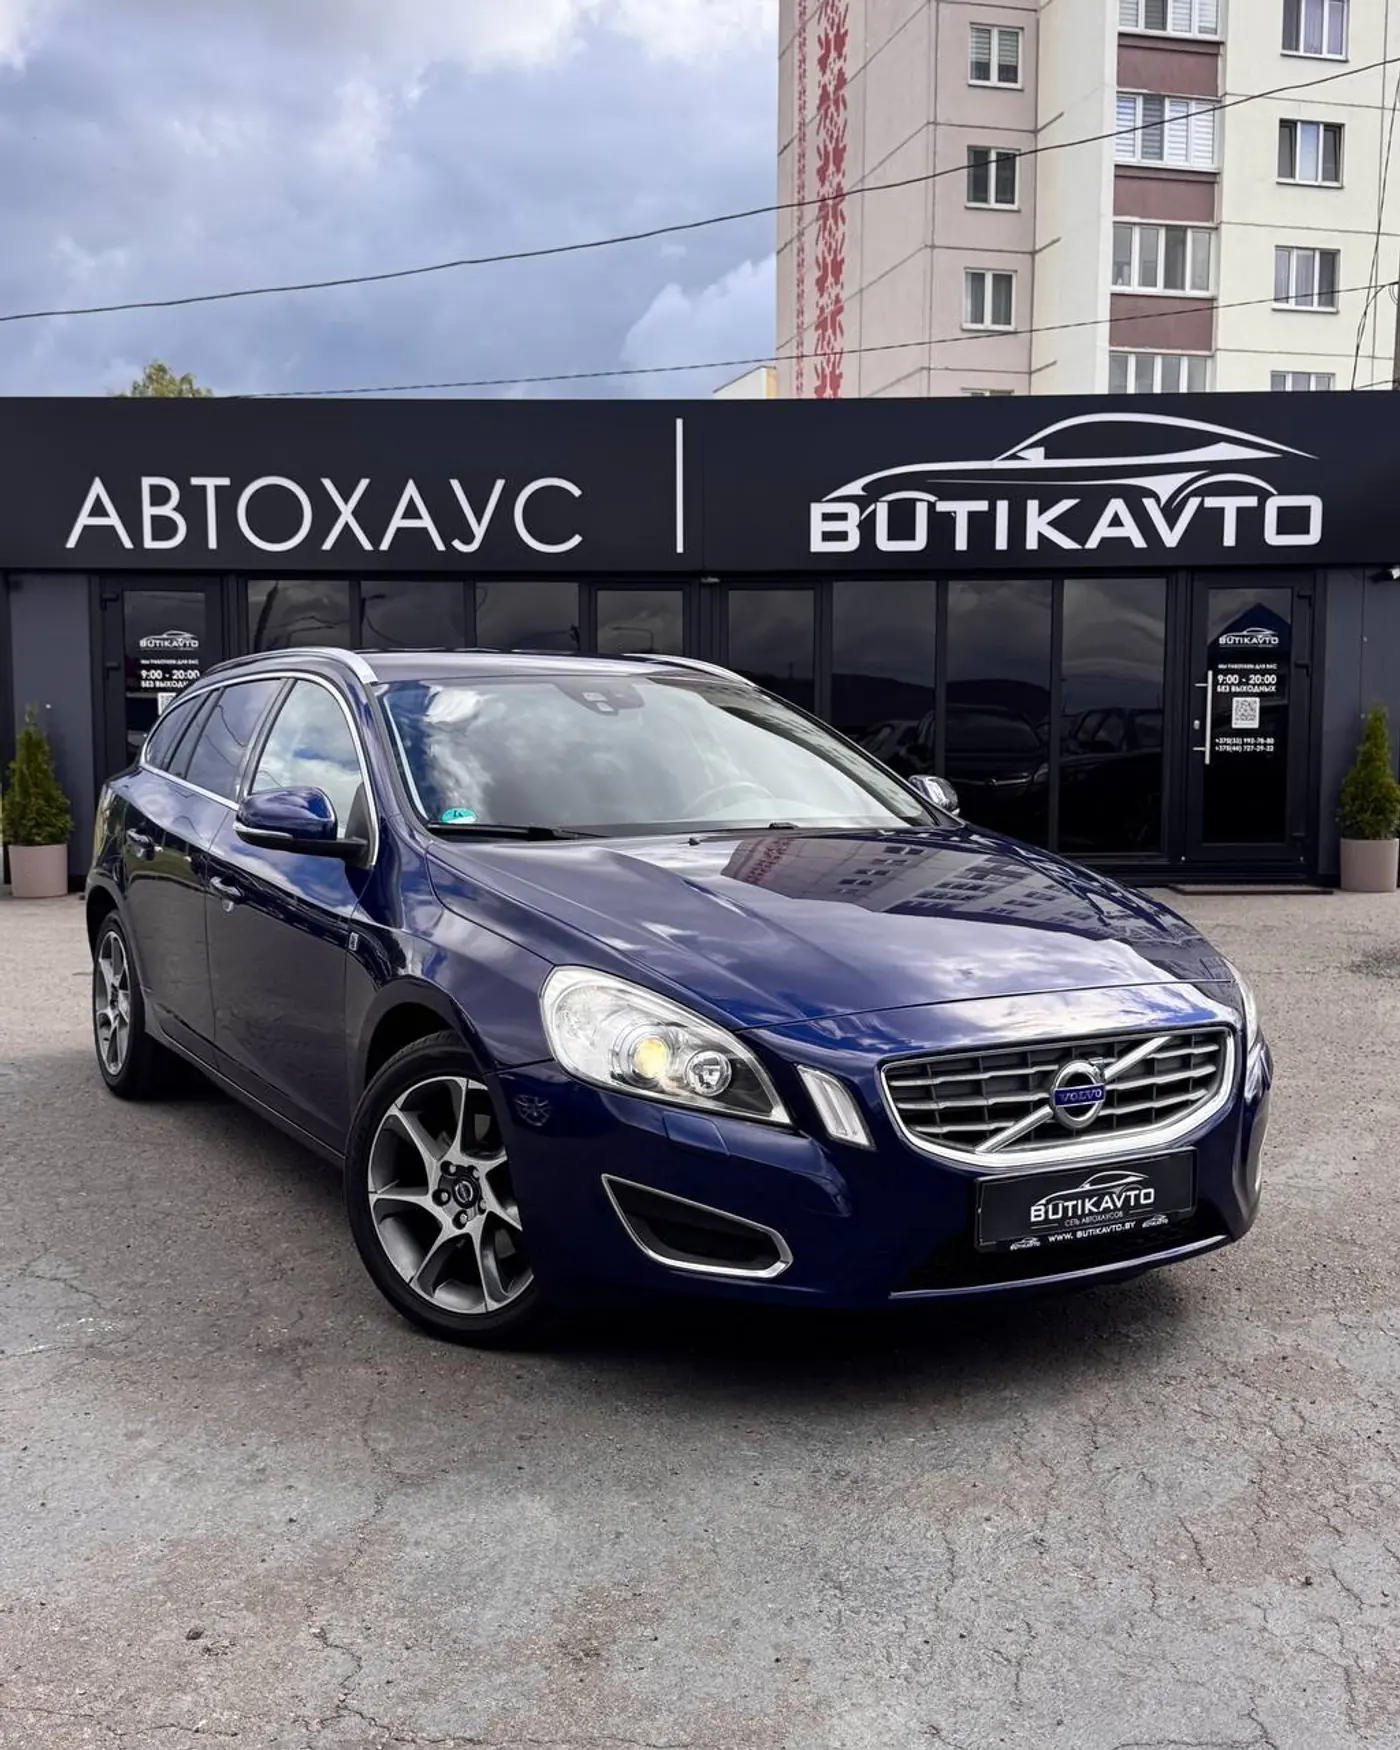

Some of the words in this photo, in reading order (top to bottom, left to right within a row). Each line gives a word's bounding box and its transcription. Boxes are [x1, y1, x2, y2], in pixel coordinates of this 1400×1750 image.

[65, 476, 584, 553] АВТОХАУС
[810, 494, 1324, 552] BUTIKAVTO
[140, 639, 199, 648] BUTIKAVTO
[1219, 636, 1279, 645] BUTIKAVTO
[141, 670, 163, 679] 9:00
[1217, 674, 1239, 684] 9:00
[1248, 674, 1277, 684] 20:00
[1058, 1089, 1101, 1101] VOLVO
[1030, 1188, 1155, 1222] BUTIKAVTO
[1081, 1211, 1123, 1224] АВТОХАУСОВ
[1048, 1232, 1073, 1242] WWW.
[1076, 1221, 1136, 1239] BUTIKAVTO.BY
